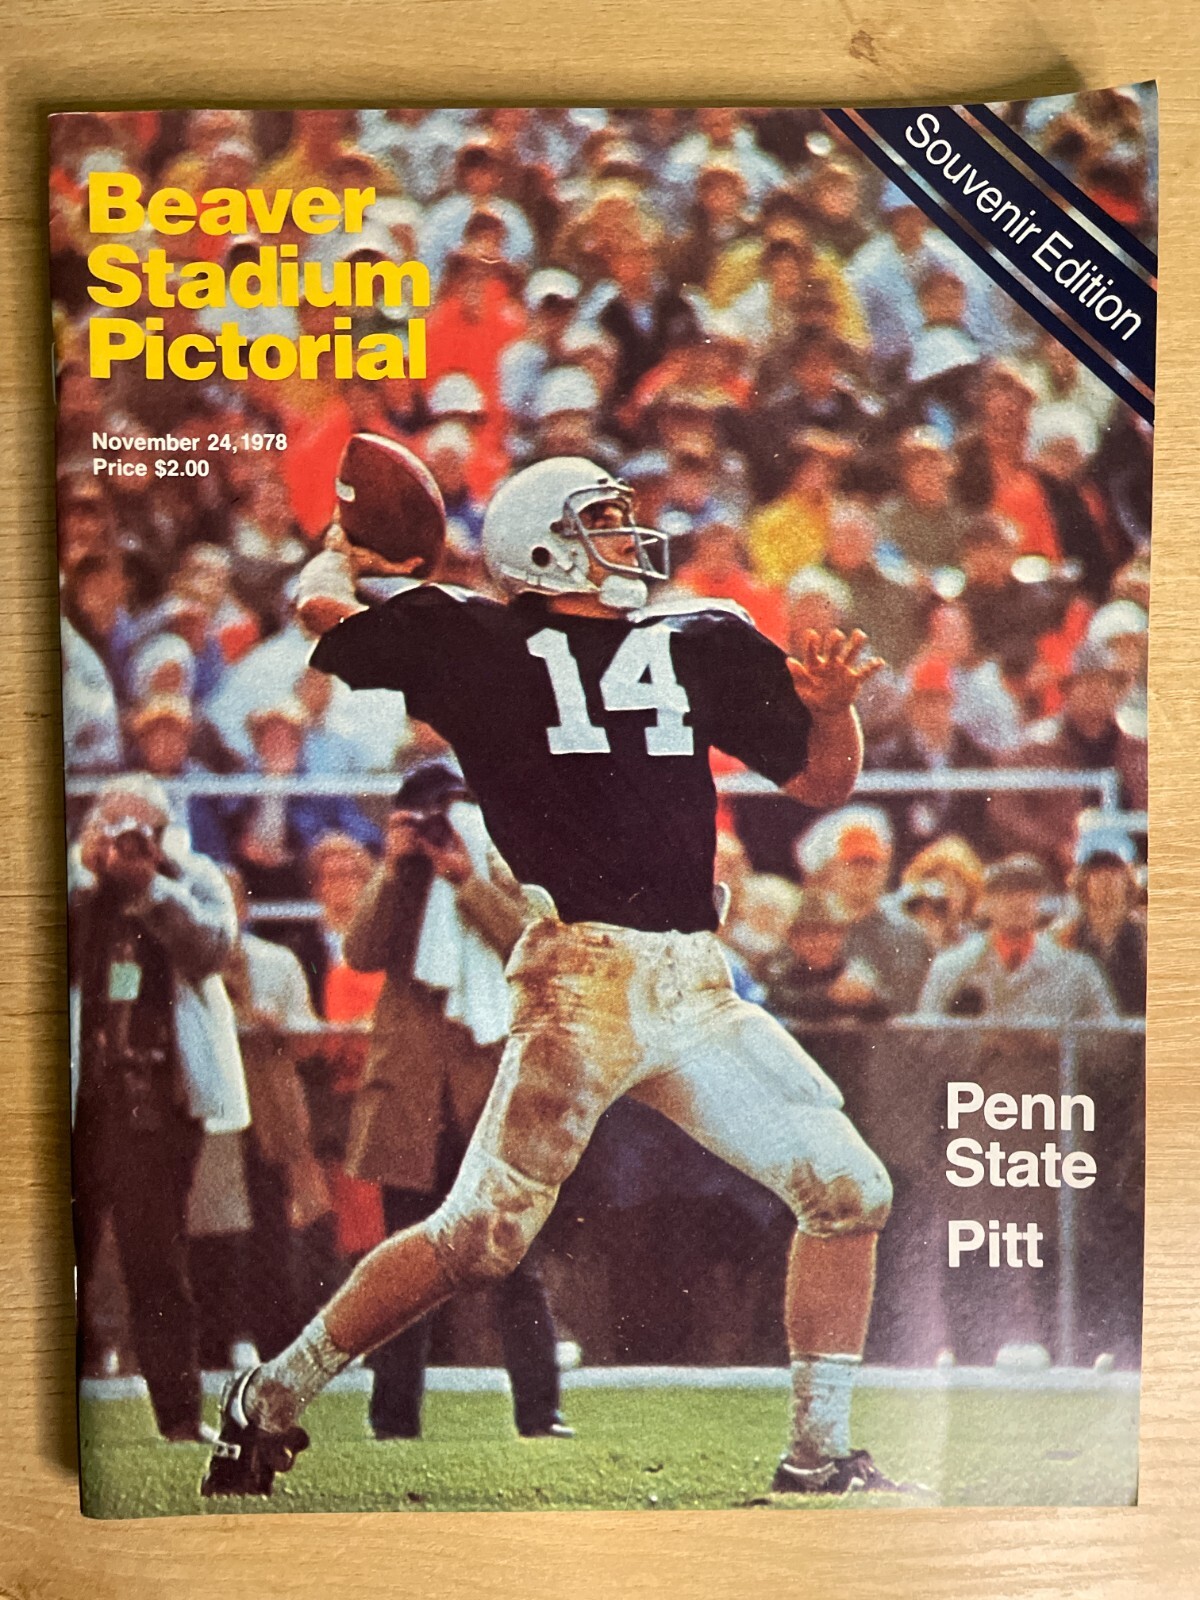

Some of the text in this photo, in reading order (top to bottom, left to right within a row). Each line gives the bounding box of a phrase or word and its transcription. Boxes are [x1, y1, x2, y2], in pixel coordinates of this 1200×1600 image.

[88, 171, 376, 236] Beaver
[904, 112, 1142, 342] Souvenir Edition
[86, 242, 431, 309] Stadium
[89, 316, 427, 381] Pictorial
[92, 432, 200, 452] November
[92, 458, 210, 478] Price $2.00
[526, 622, 694, 757] 14
[946, 1081, 1096, 1132] Penn
[945, 1137, 1098, 1189] State
[947, 1219, 1044, 1268] Pitt
